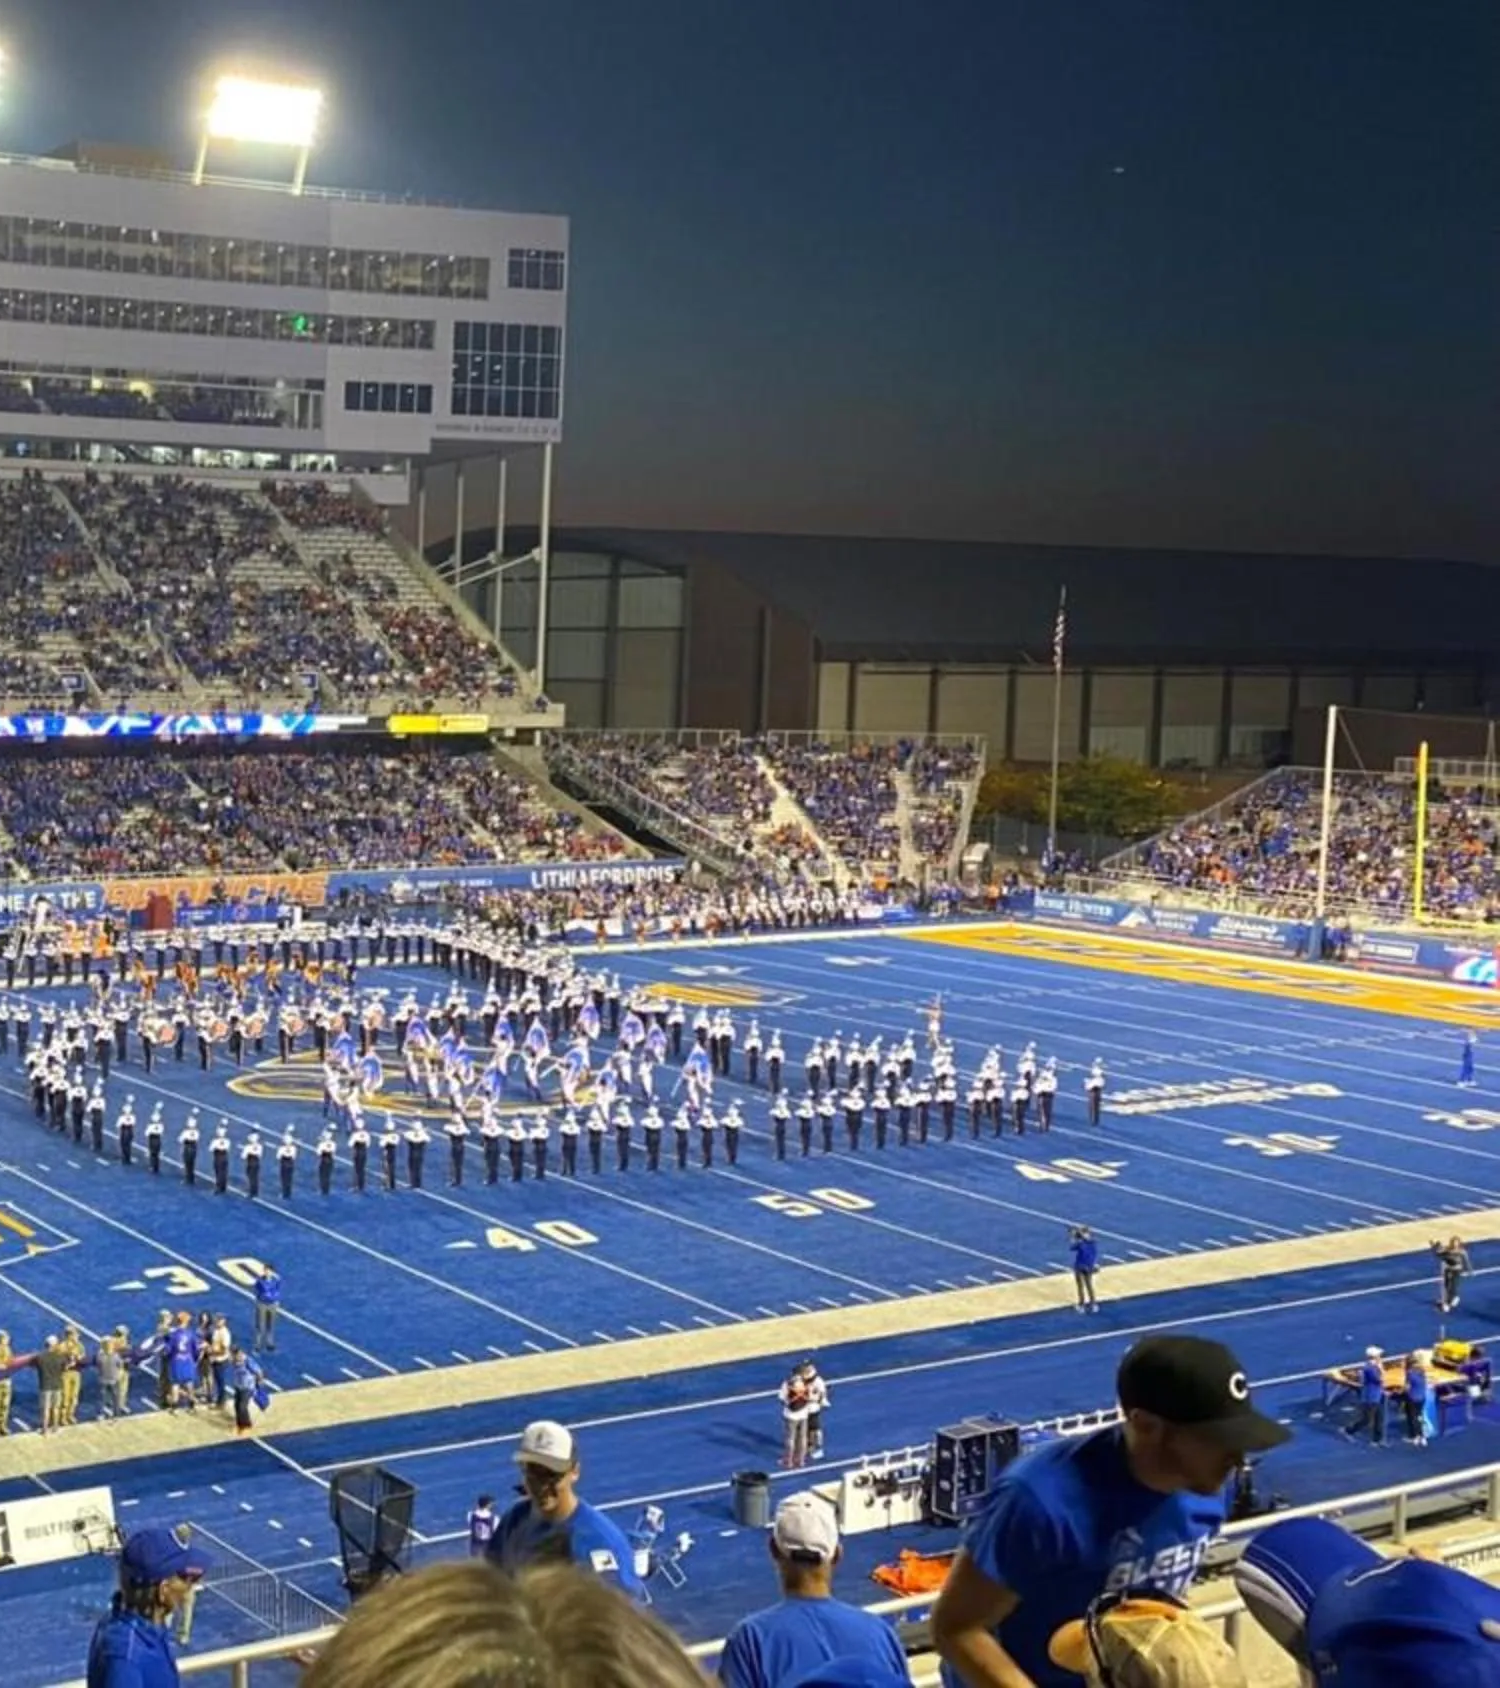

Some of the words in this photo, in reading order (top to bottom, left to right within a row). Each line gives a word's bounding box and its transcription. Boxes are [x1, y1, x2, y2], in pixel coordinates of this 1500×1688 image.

[749, 1187, 876, 1217] 50
[485, 1220, 599, 1251] 40
[1229, 1371, 1248, 1400] C
